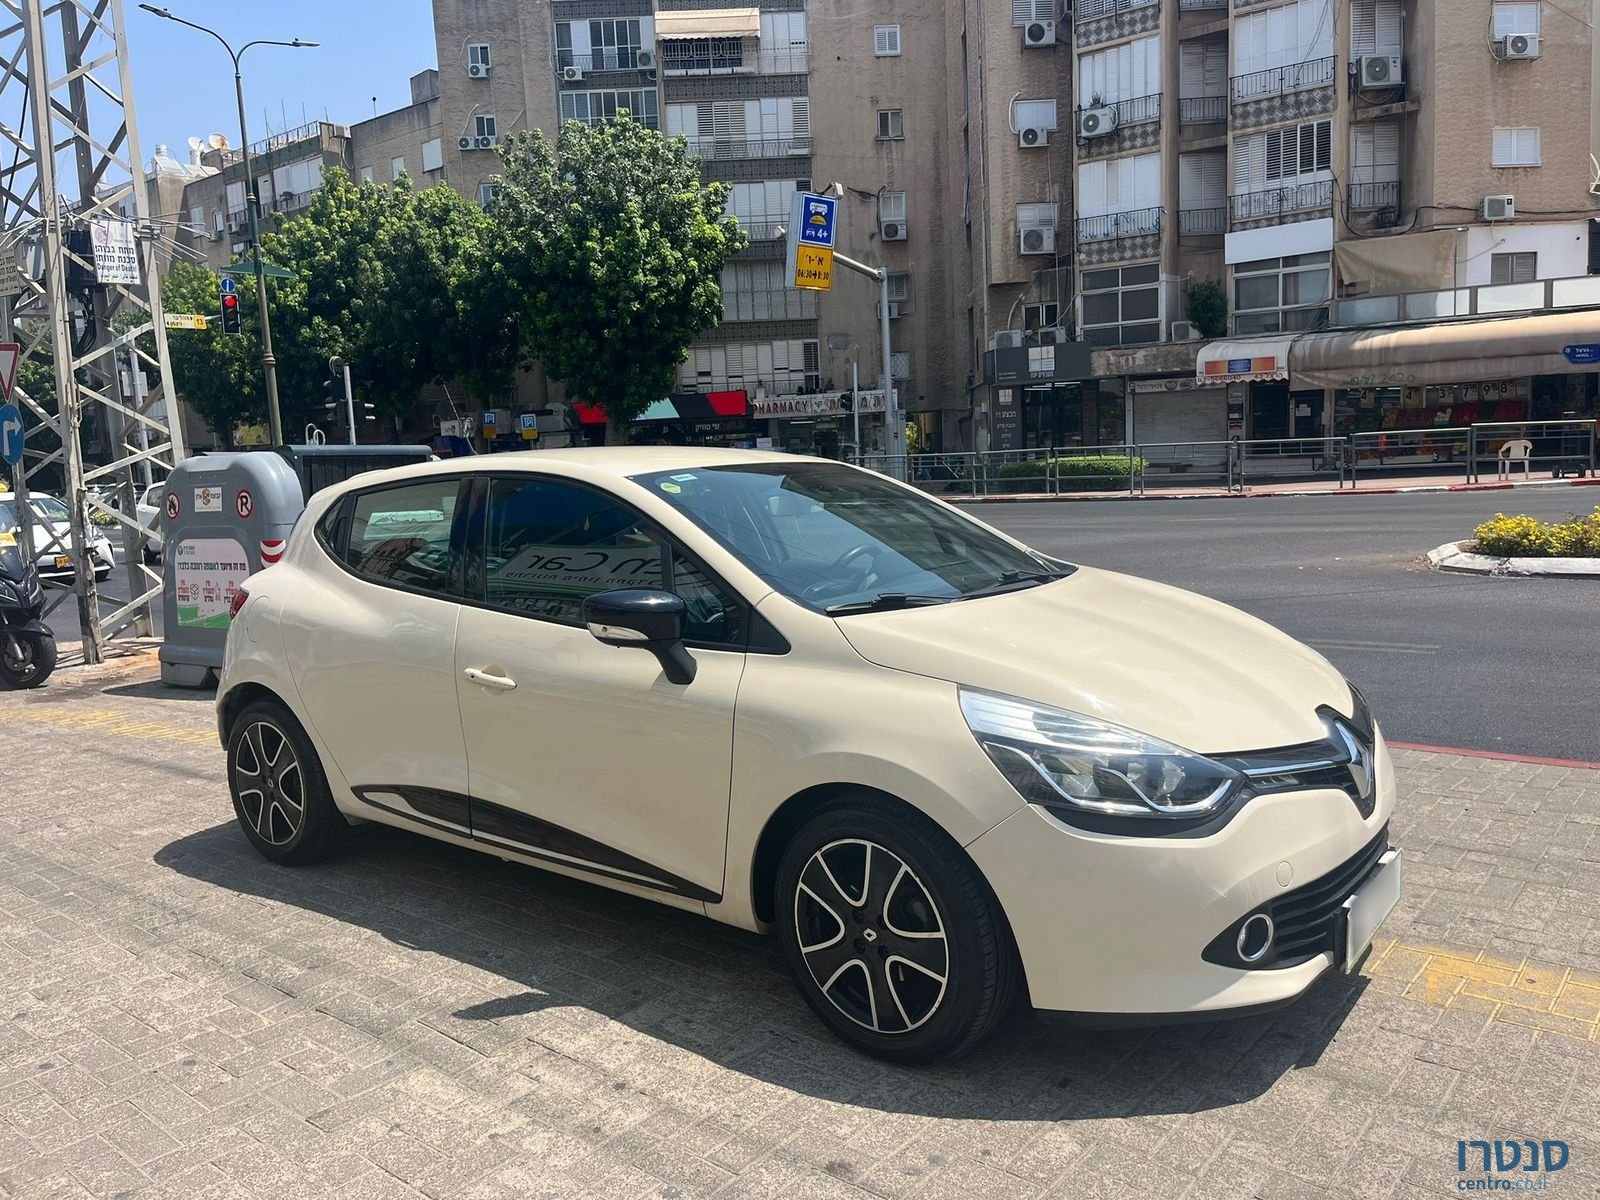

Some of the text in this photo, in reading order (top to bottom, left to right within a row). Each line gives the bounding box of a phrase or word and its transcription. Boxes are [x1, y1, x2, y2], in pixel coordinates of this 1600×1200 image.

[117, 246, 135, 255] מתח
[117, 255, 136, 264] סכנת
[196, 318, 204, 326] 13
[752, 399, 807, 414] PHARMACY
